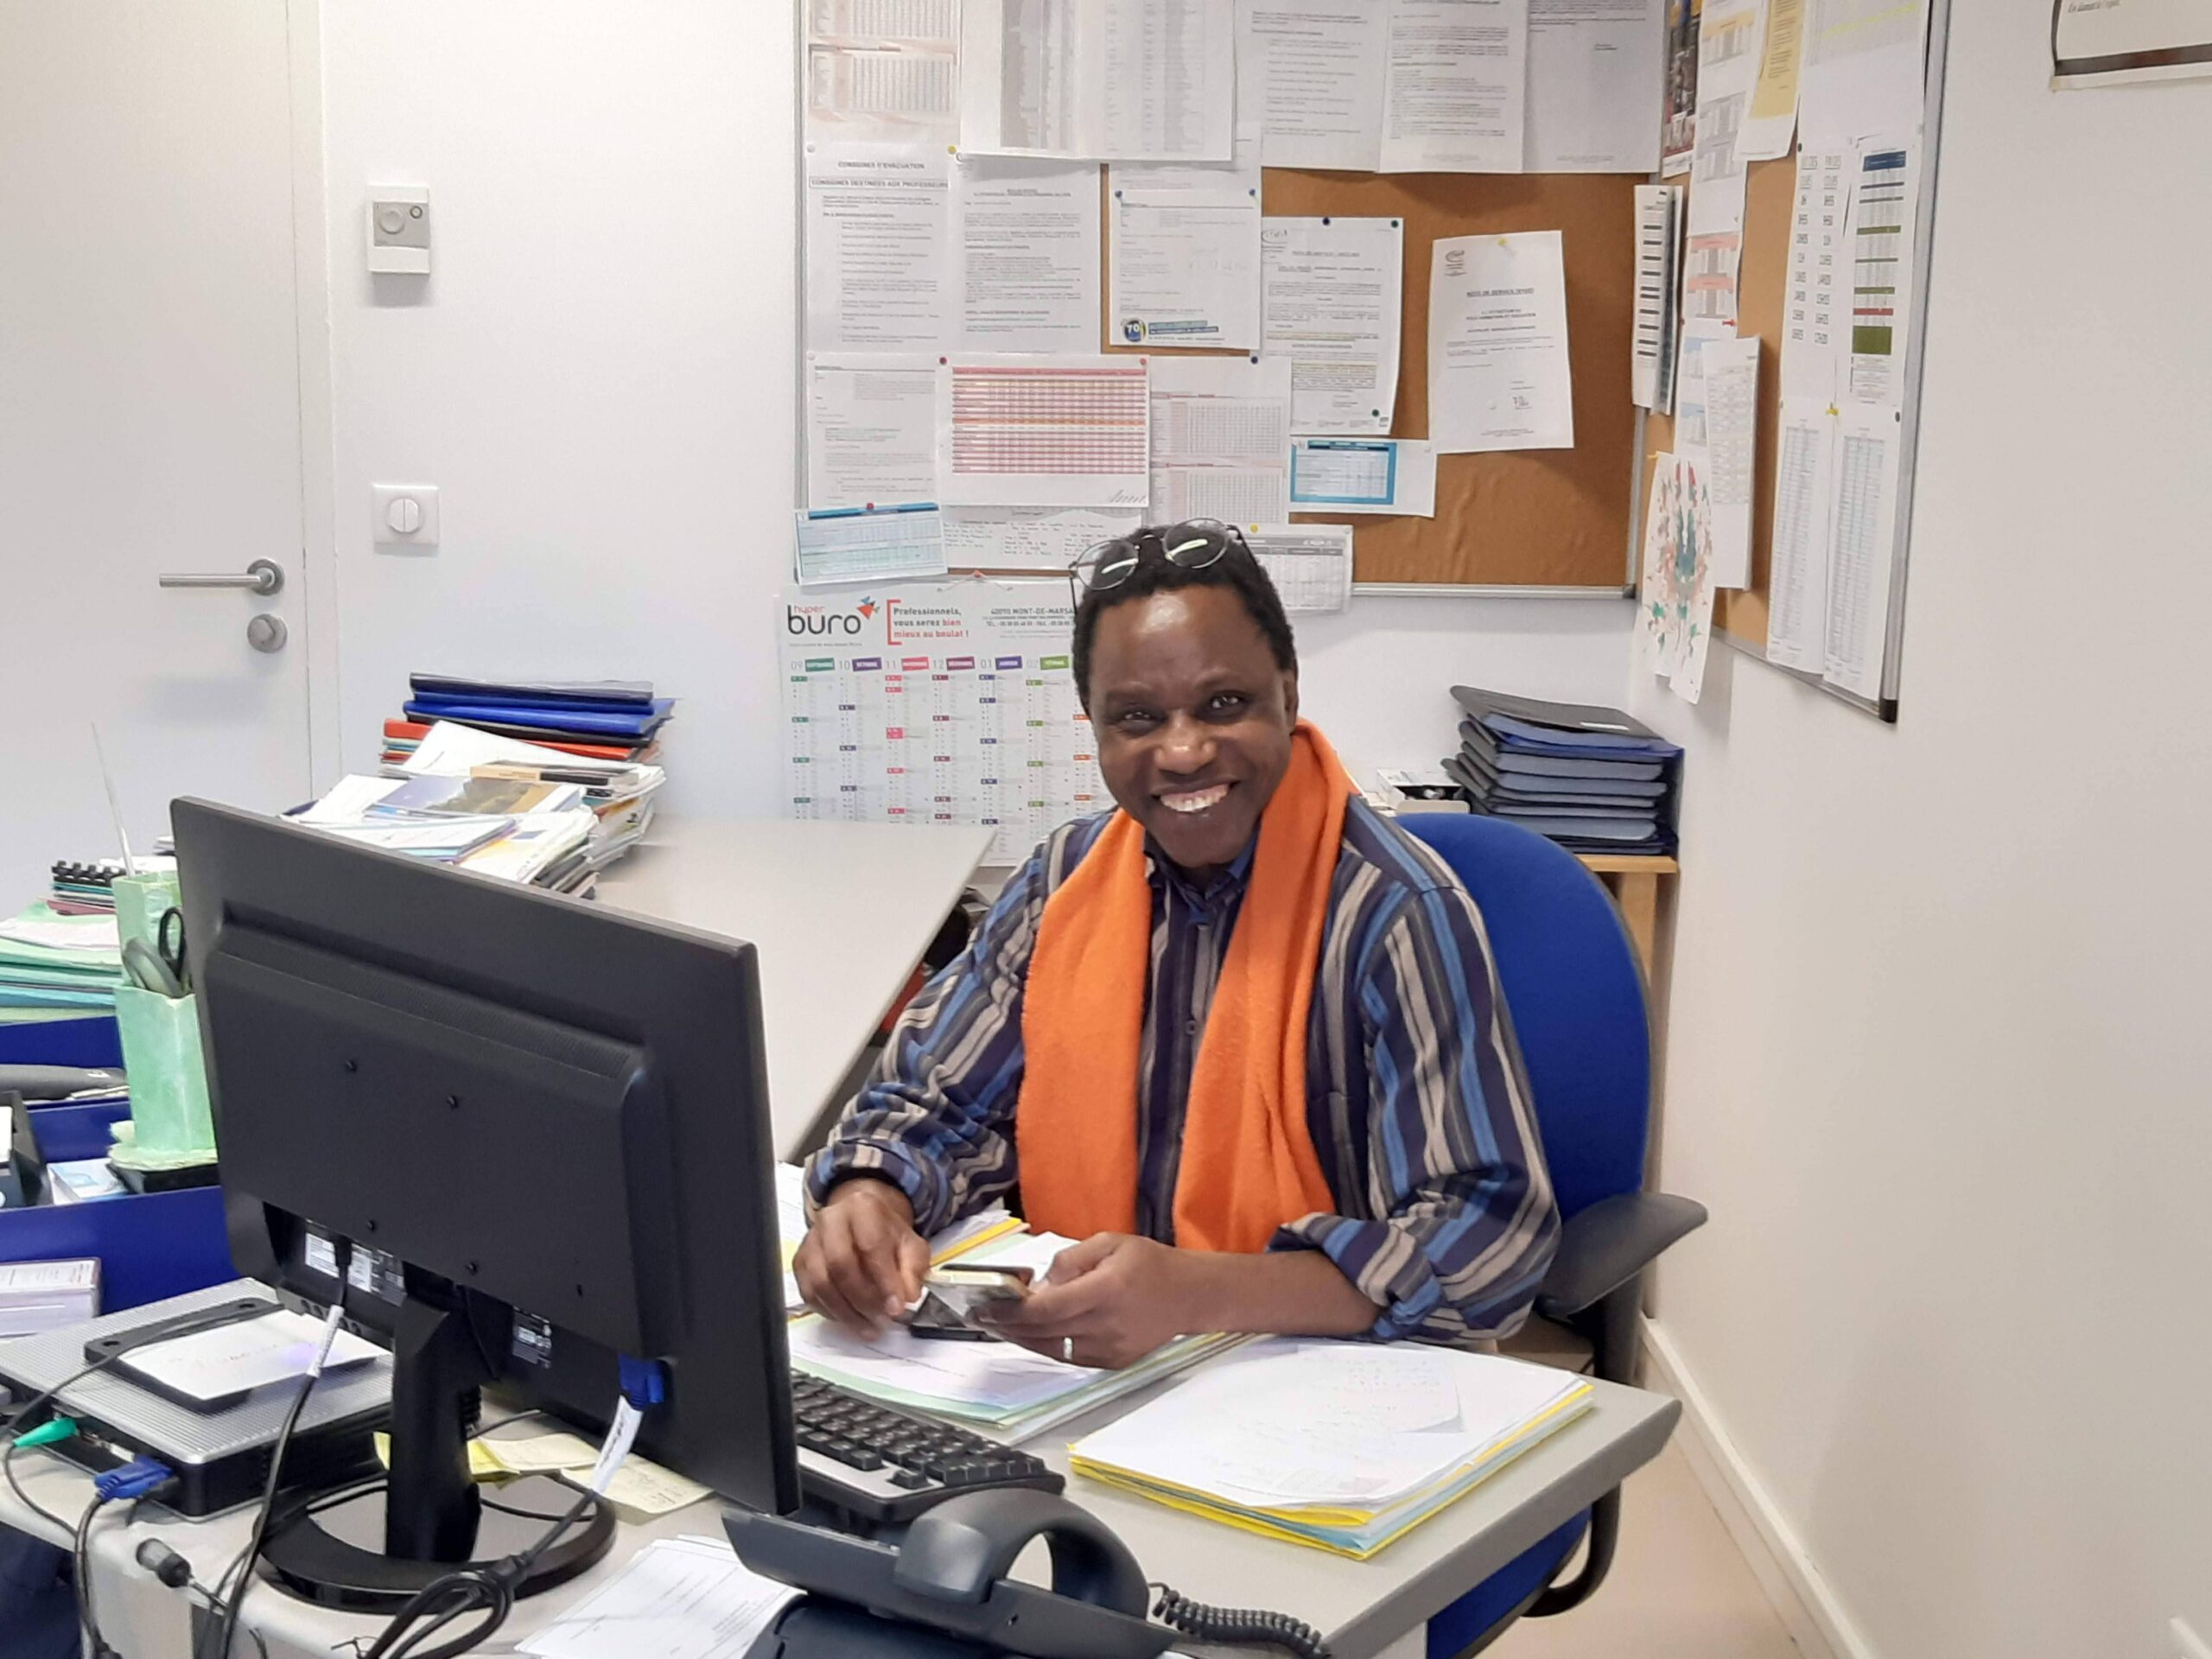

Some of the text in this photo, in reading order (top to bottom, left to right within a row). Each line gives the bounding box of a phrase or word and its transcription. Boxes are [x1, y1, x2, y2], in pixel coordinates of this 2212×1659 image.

[793, 605, 825, 615] hyper
[893, 607, 962, 616] Professionnels,
[787, 604, 861, 635] buro
[942, 618, 962, 626] bien
[893, 629, 920, 638] mieux
[839, 659, 850, 670] 10
[886, 659, 897, 670] 11
[933, 659, 944, 670] 12
[980, 658, 993, 669] 01
